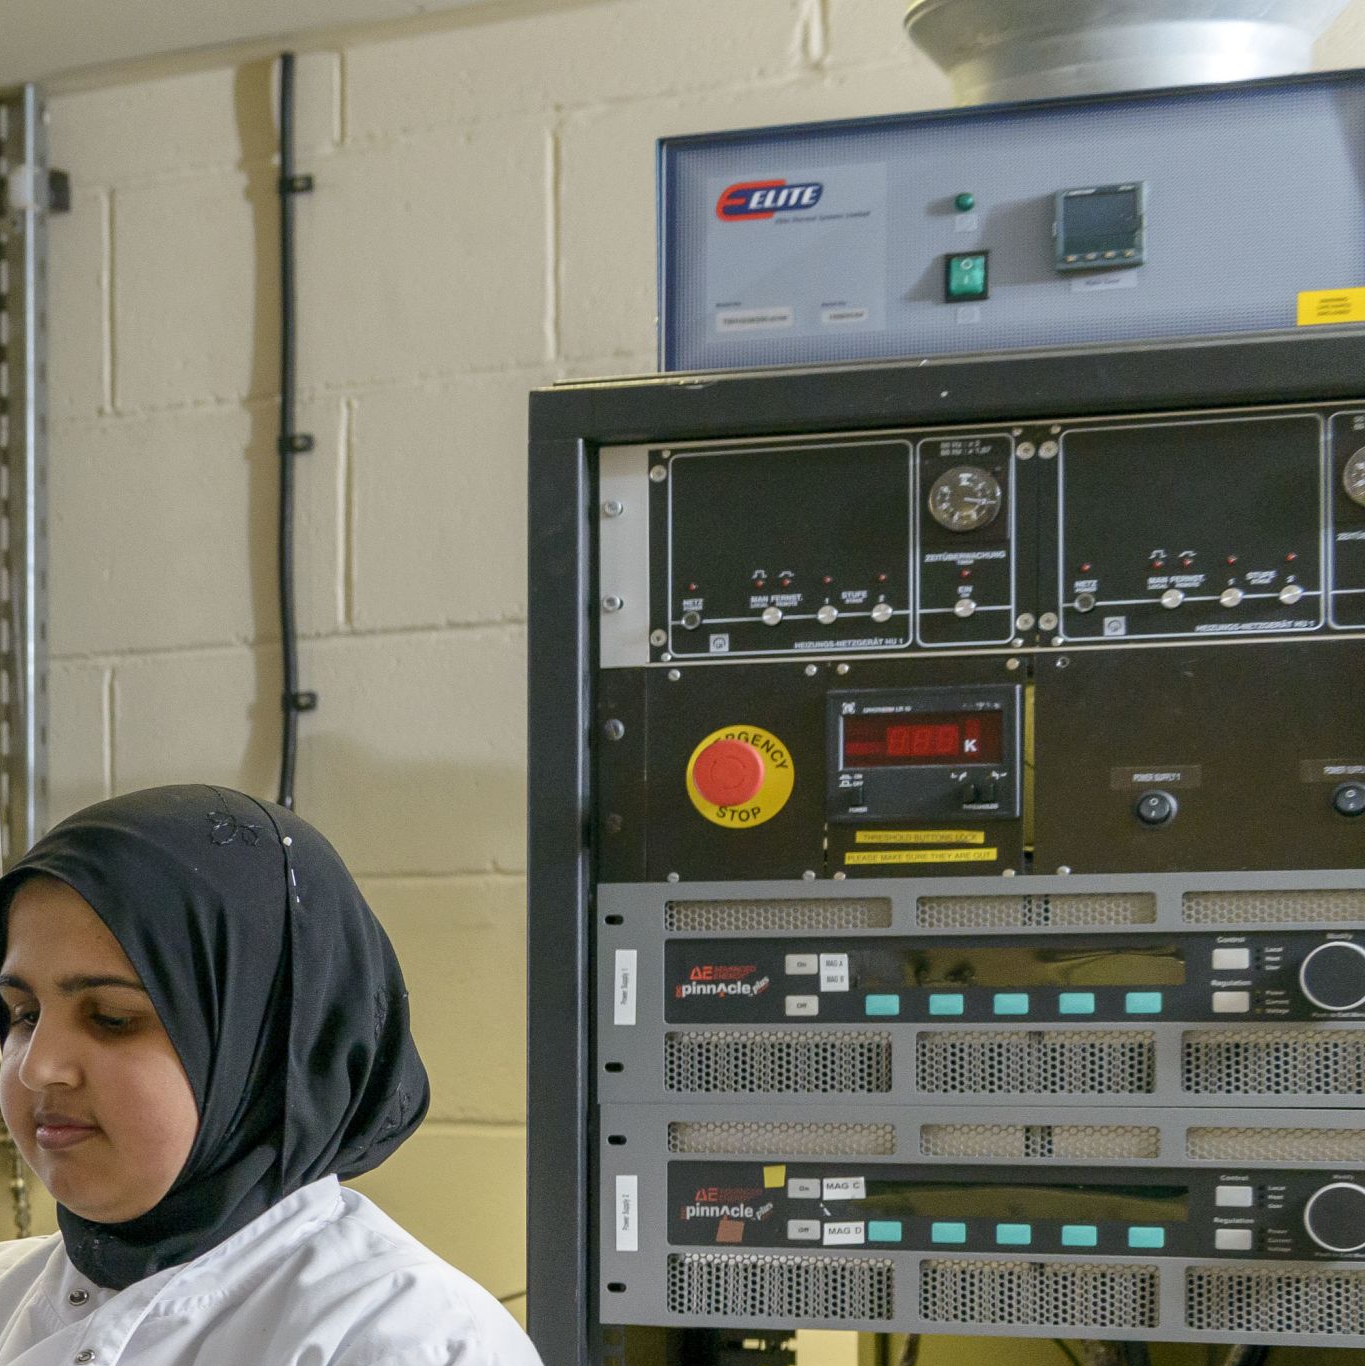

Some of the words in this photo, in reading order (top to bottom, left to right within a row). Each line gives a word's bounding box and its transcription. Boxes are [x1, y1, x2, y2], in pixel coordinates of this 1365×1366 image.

[749, 186, 818, 210] ELITE
[964, 739, 977, 752] K
[716, 806, 761, 822] STOP
[848, 853, 877, 862] PLEASE
[1210, 979, 1252, 988] Regulation
[826, 1182, 849, 1191] MAG
[853, 1181, 861, 1190] C
[1213, 1216, 1255, 1224] Regulation
[828, 1226, 851, 1236] MAG
[854, 1227, 862, 1235] D
